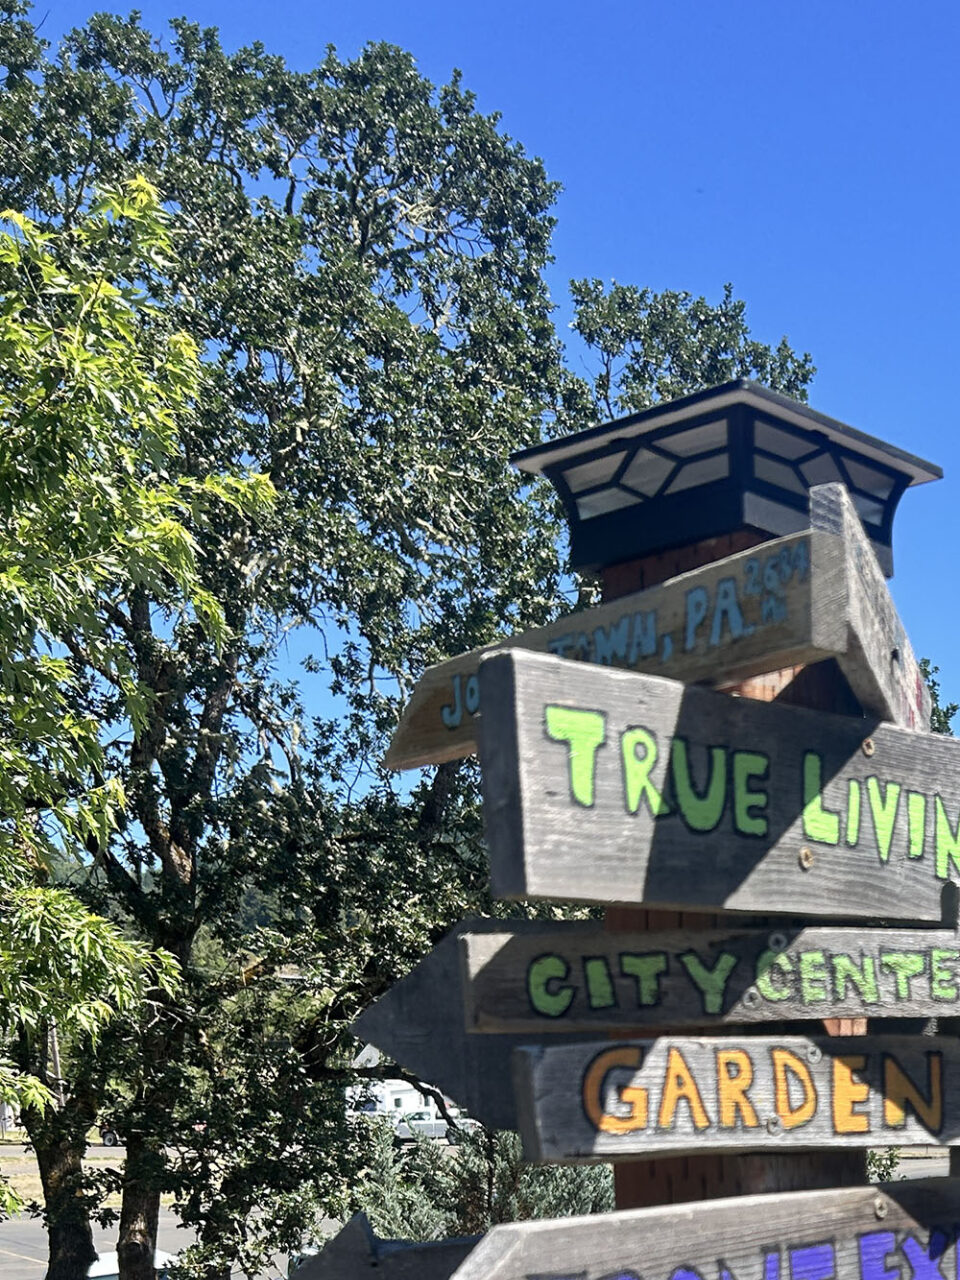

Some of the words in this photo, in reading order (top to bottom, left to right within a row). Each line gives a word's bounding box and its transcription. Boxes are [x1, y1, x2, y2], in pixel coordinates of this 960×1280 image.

[544, 703, 770, 838] TRUE
[526, 952, 740, 1018] CITY
[581, 1045, 944, 1136] GARDEN
